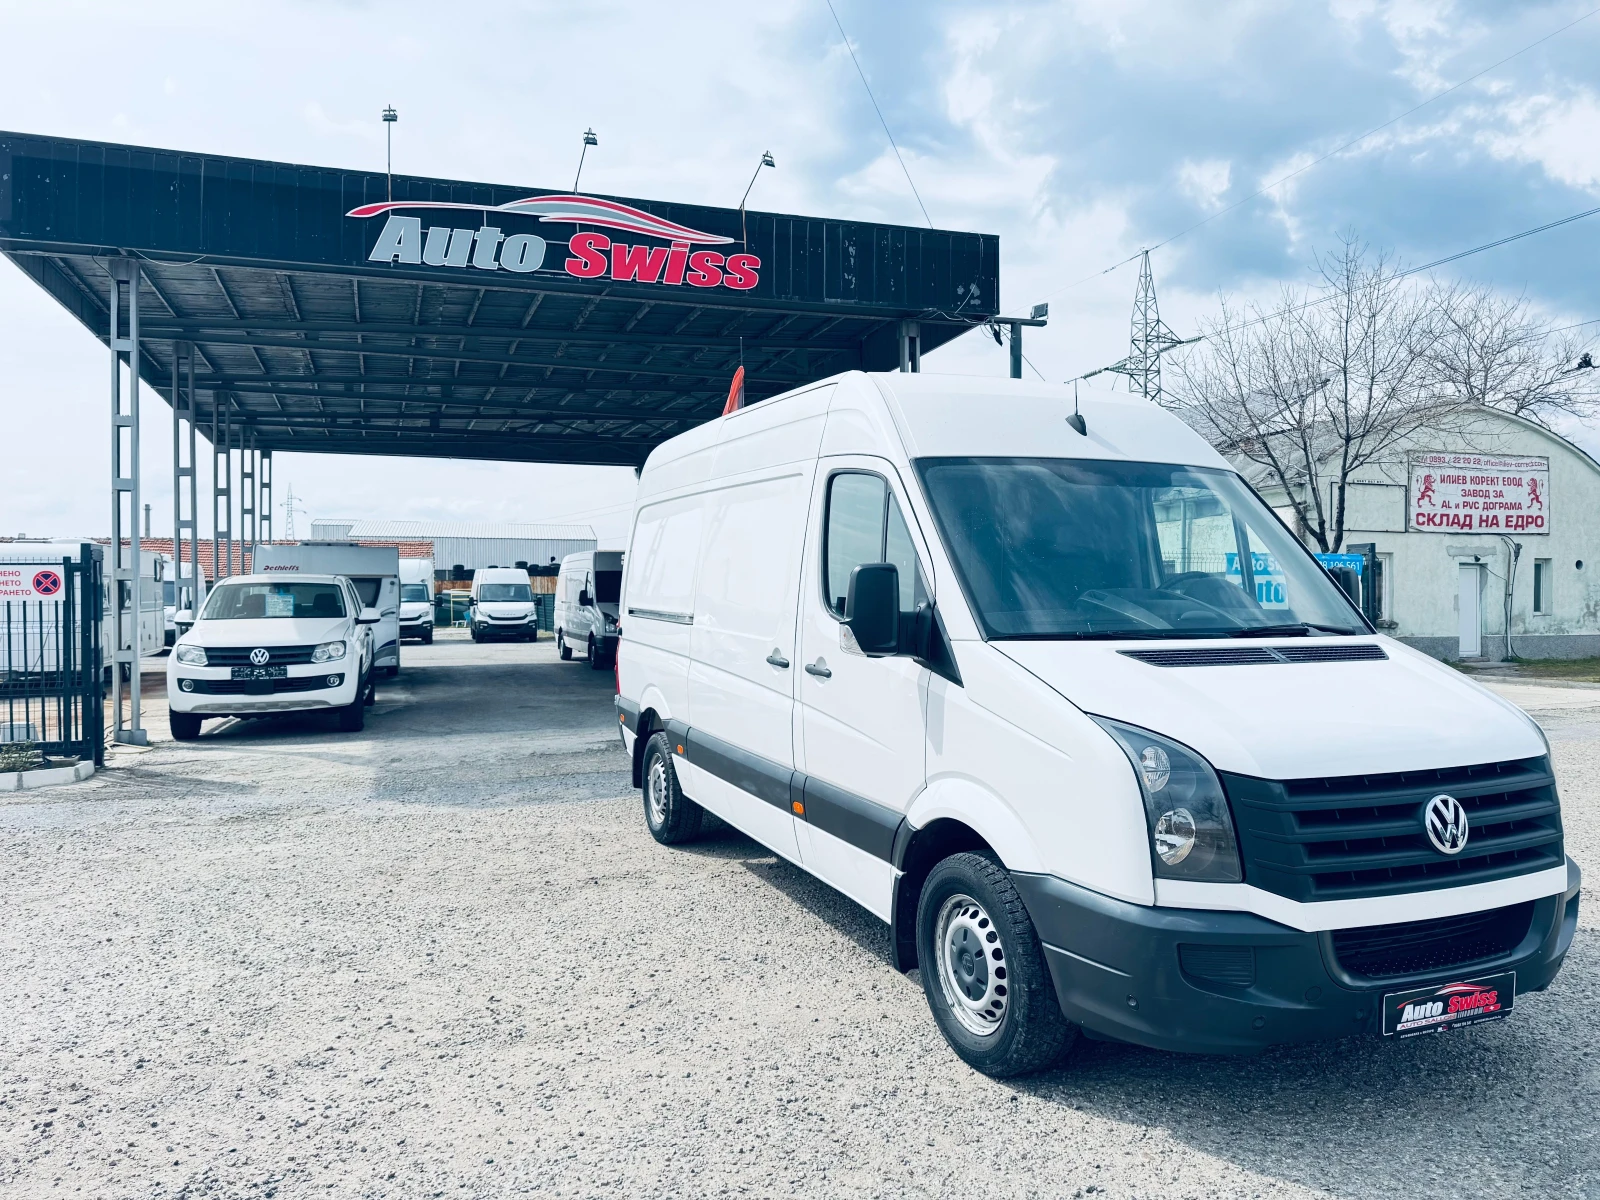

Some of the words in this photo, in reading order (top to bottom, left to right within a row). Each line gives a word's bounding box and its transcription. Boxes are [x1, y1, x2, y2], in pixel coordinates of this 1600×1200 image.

[368, 215, 546, 273] Auto
[564, 232, 761, 291] Swiss
[1440, 474, 1467, 485] ИЛИЕВ
[1470, 475, 1499, 486] КОРЕКТ
[1502, 477, 1523, 487] ЕООД
[1461, 489, 1491, 499] ЗАВОД
[1493, 490, 1504, 498] ЗА
[1441, 500, 1452, 509] AL
[1463, 500, 1479, 509] PVC
[1482, 501, 1523, 511] ДОГРАМА
[1415, 513, 1473, 530] СКЛАД
[1478, 514, 1500, 528] НА
[1505, 515, 1545, 530] ЕДРО
[1232, 557, 1265, 571] Ato
[1425, 794, 1469, 855] VW
[1401, 1001, 1444, 1022] Auto
[1448, 990, 1497, 1013] Swiss
[1400, 1020, 1424, 1030] AUTO
